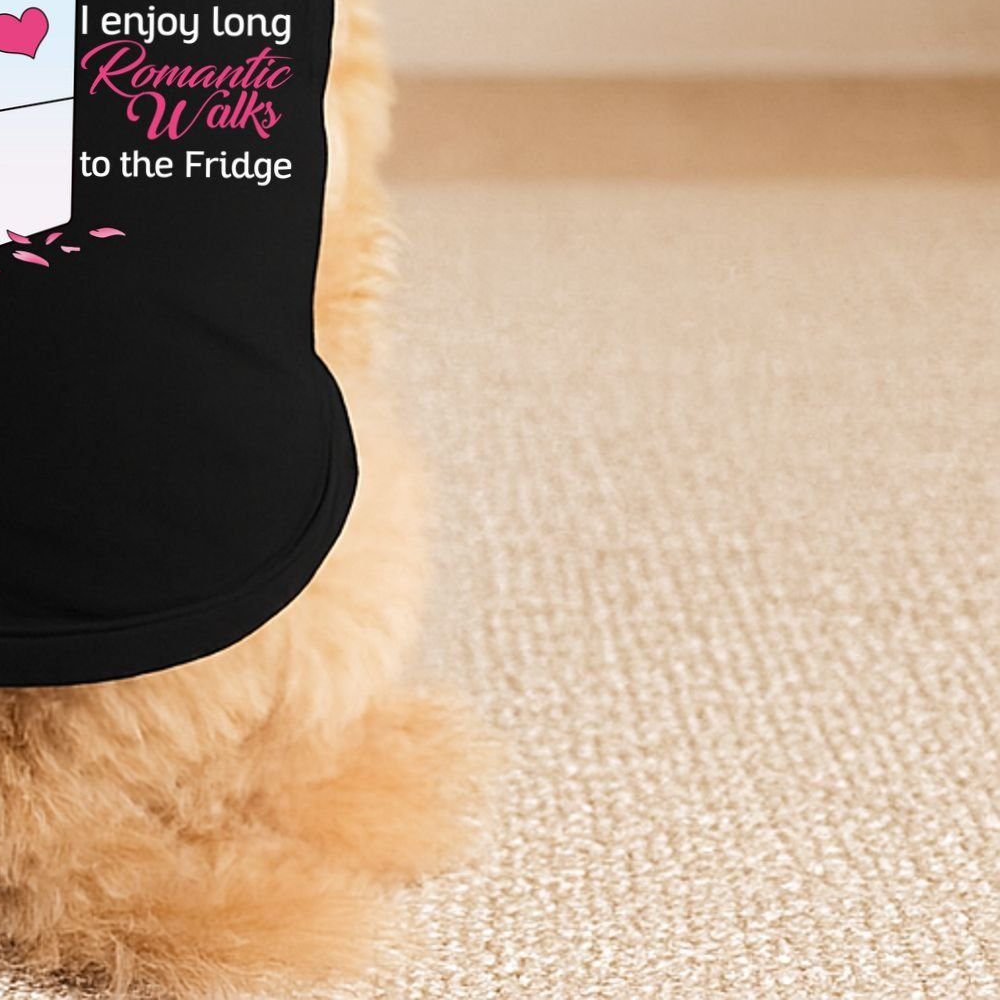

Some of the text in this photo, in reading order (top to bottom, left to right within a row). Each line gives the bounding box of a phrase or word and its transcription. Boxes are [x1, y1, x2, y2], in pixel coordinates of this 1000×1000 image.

[81, 4, 293, 46] I enjoy long
[80, 39, 295, 98] Romantic
[126, 89, 283, 141] Walks
[79, 150, 293, 187] to the Fridge
